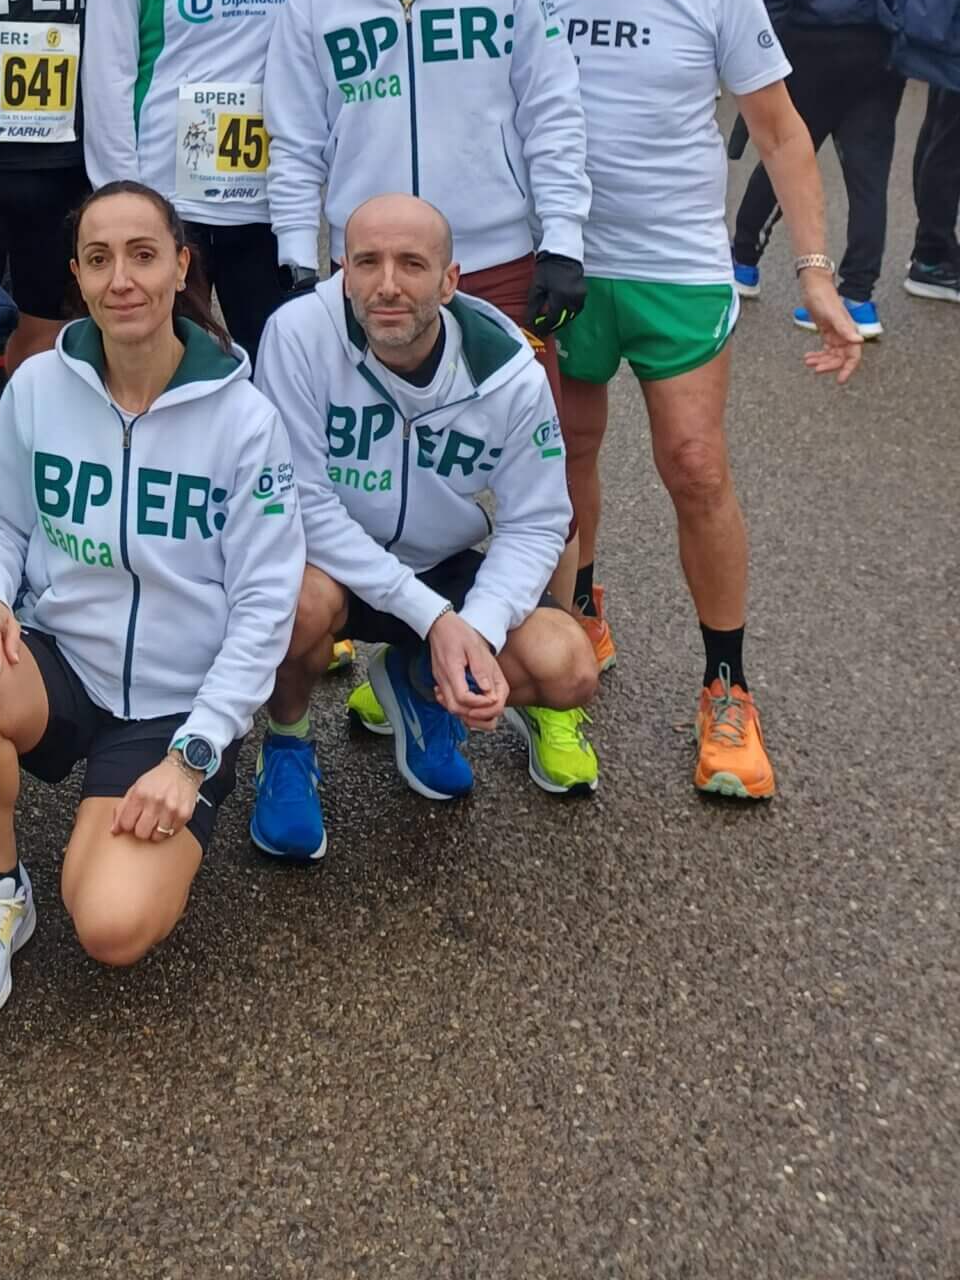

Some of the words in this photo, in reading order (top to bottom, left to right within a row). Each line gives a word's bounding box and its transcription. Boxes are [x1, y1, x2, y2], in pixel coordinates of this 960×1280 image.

[560, 19, 650, 48] PER:
[4, 56, 69, 107] 641
[194, 91, 245, 105] BPER:
[7, 127, 51, 137] KARHU
[218, 118, 264, 168] 45
[222, 188, 259, 199] KARHU
[34, 451, 227, 540] BPER:
[40, 515, 114, 568] Banca
